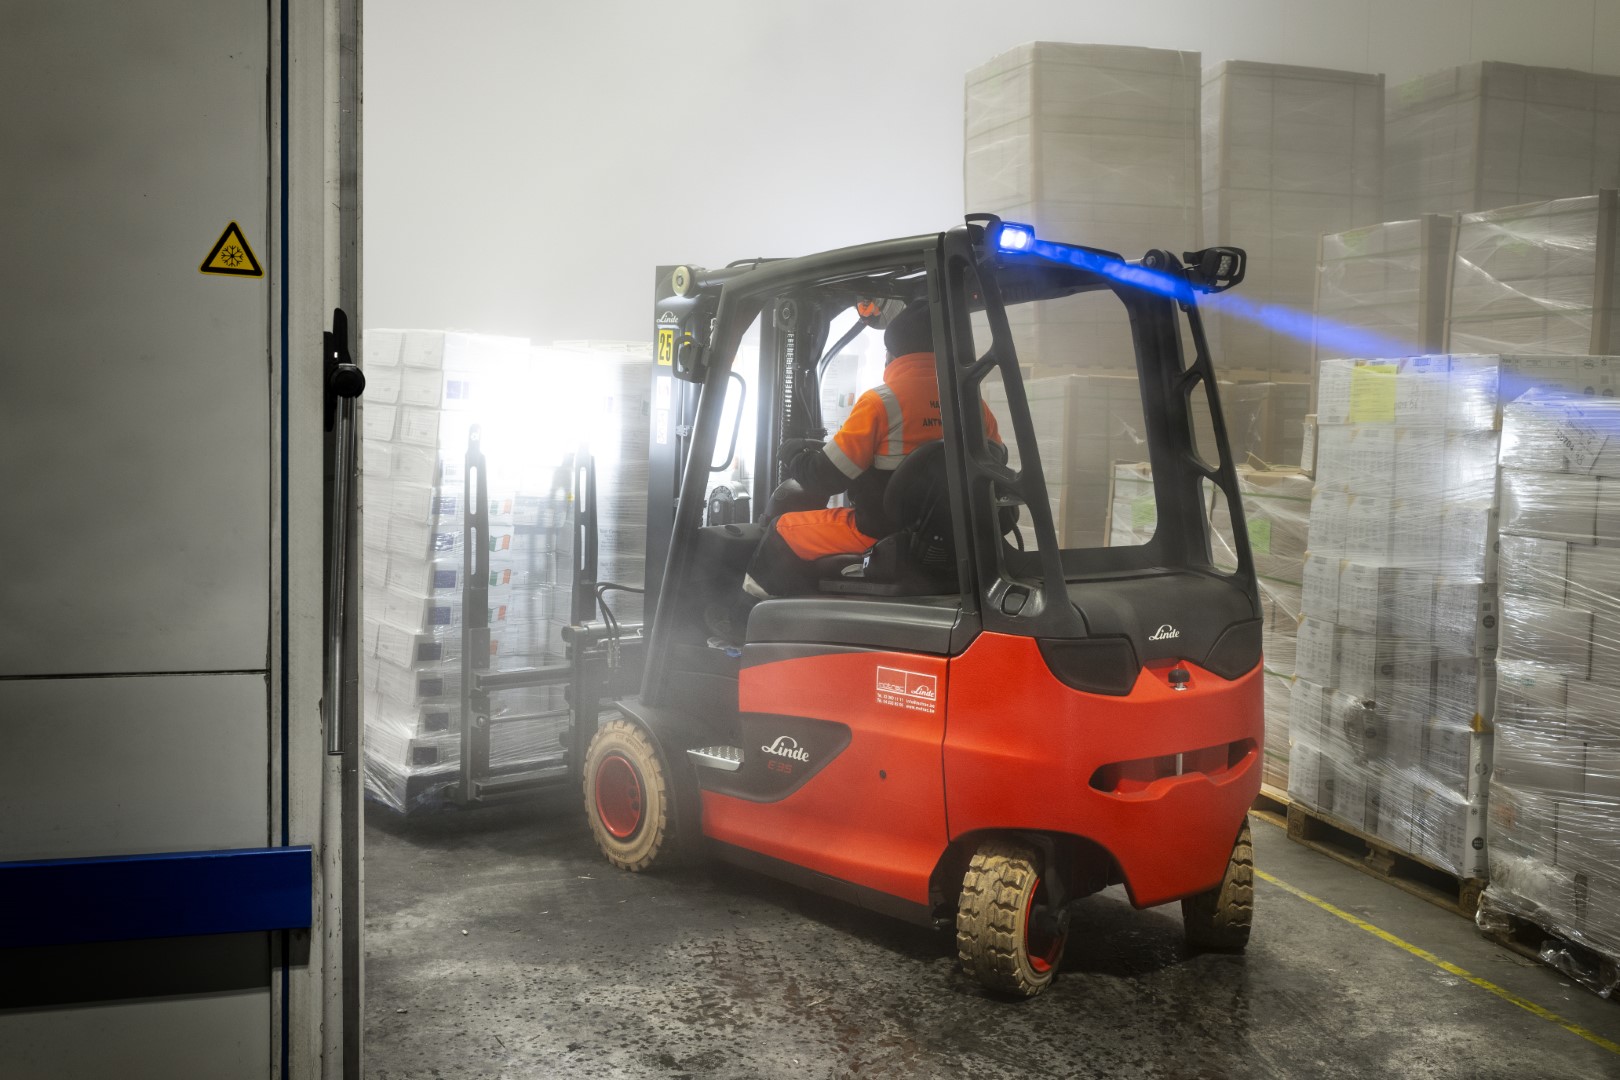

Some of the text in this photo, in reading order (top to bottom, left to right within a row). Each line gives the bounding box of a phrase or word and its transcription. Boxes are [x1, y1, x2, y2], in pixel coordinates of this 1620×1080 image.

[656, 311, 678, 323] Linde
[659, 333, 671, 361] 25
[1148, 624, 1180, 641] Linde
[911, 685, 934, 697] Linde
[761, 735, 810, 762] Linde
